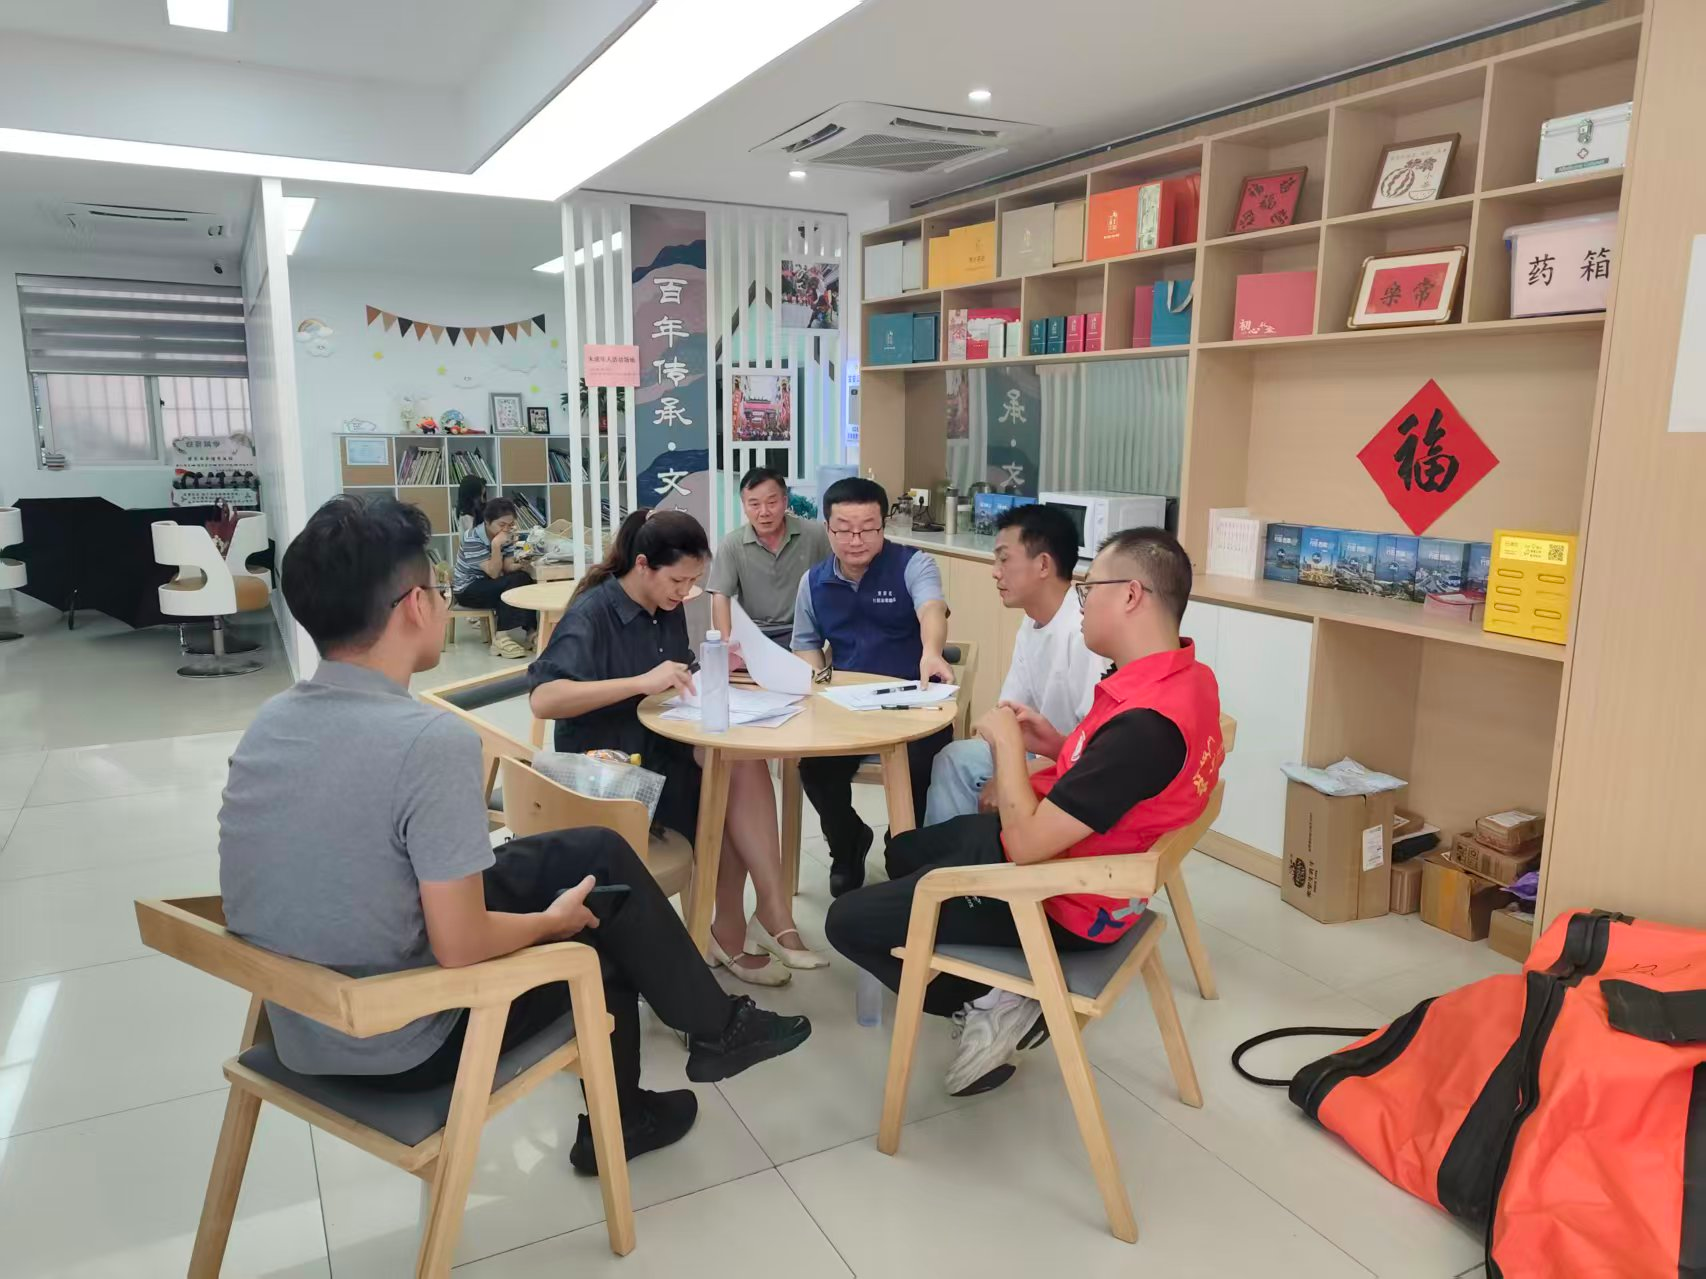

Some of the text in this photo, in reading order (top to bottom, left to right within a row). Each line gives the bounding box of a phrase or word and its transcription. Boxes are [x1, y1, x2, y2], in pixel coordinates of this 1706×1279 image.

[1528, 247, 1611, 286] 药箱
[652, 278, 692, 512] 百年传承·文
[1394, 407, 1460, 493] 福
